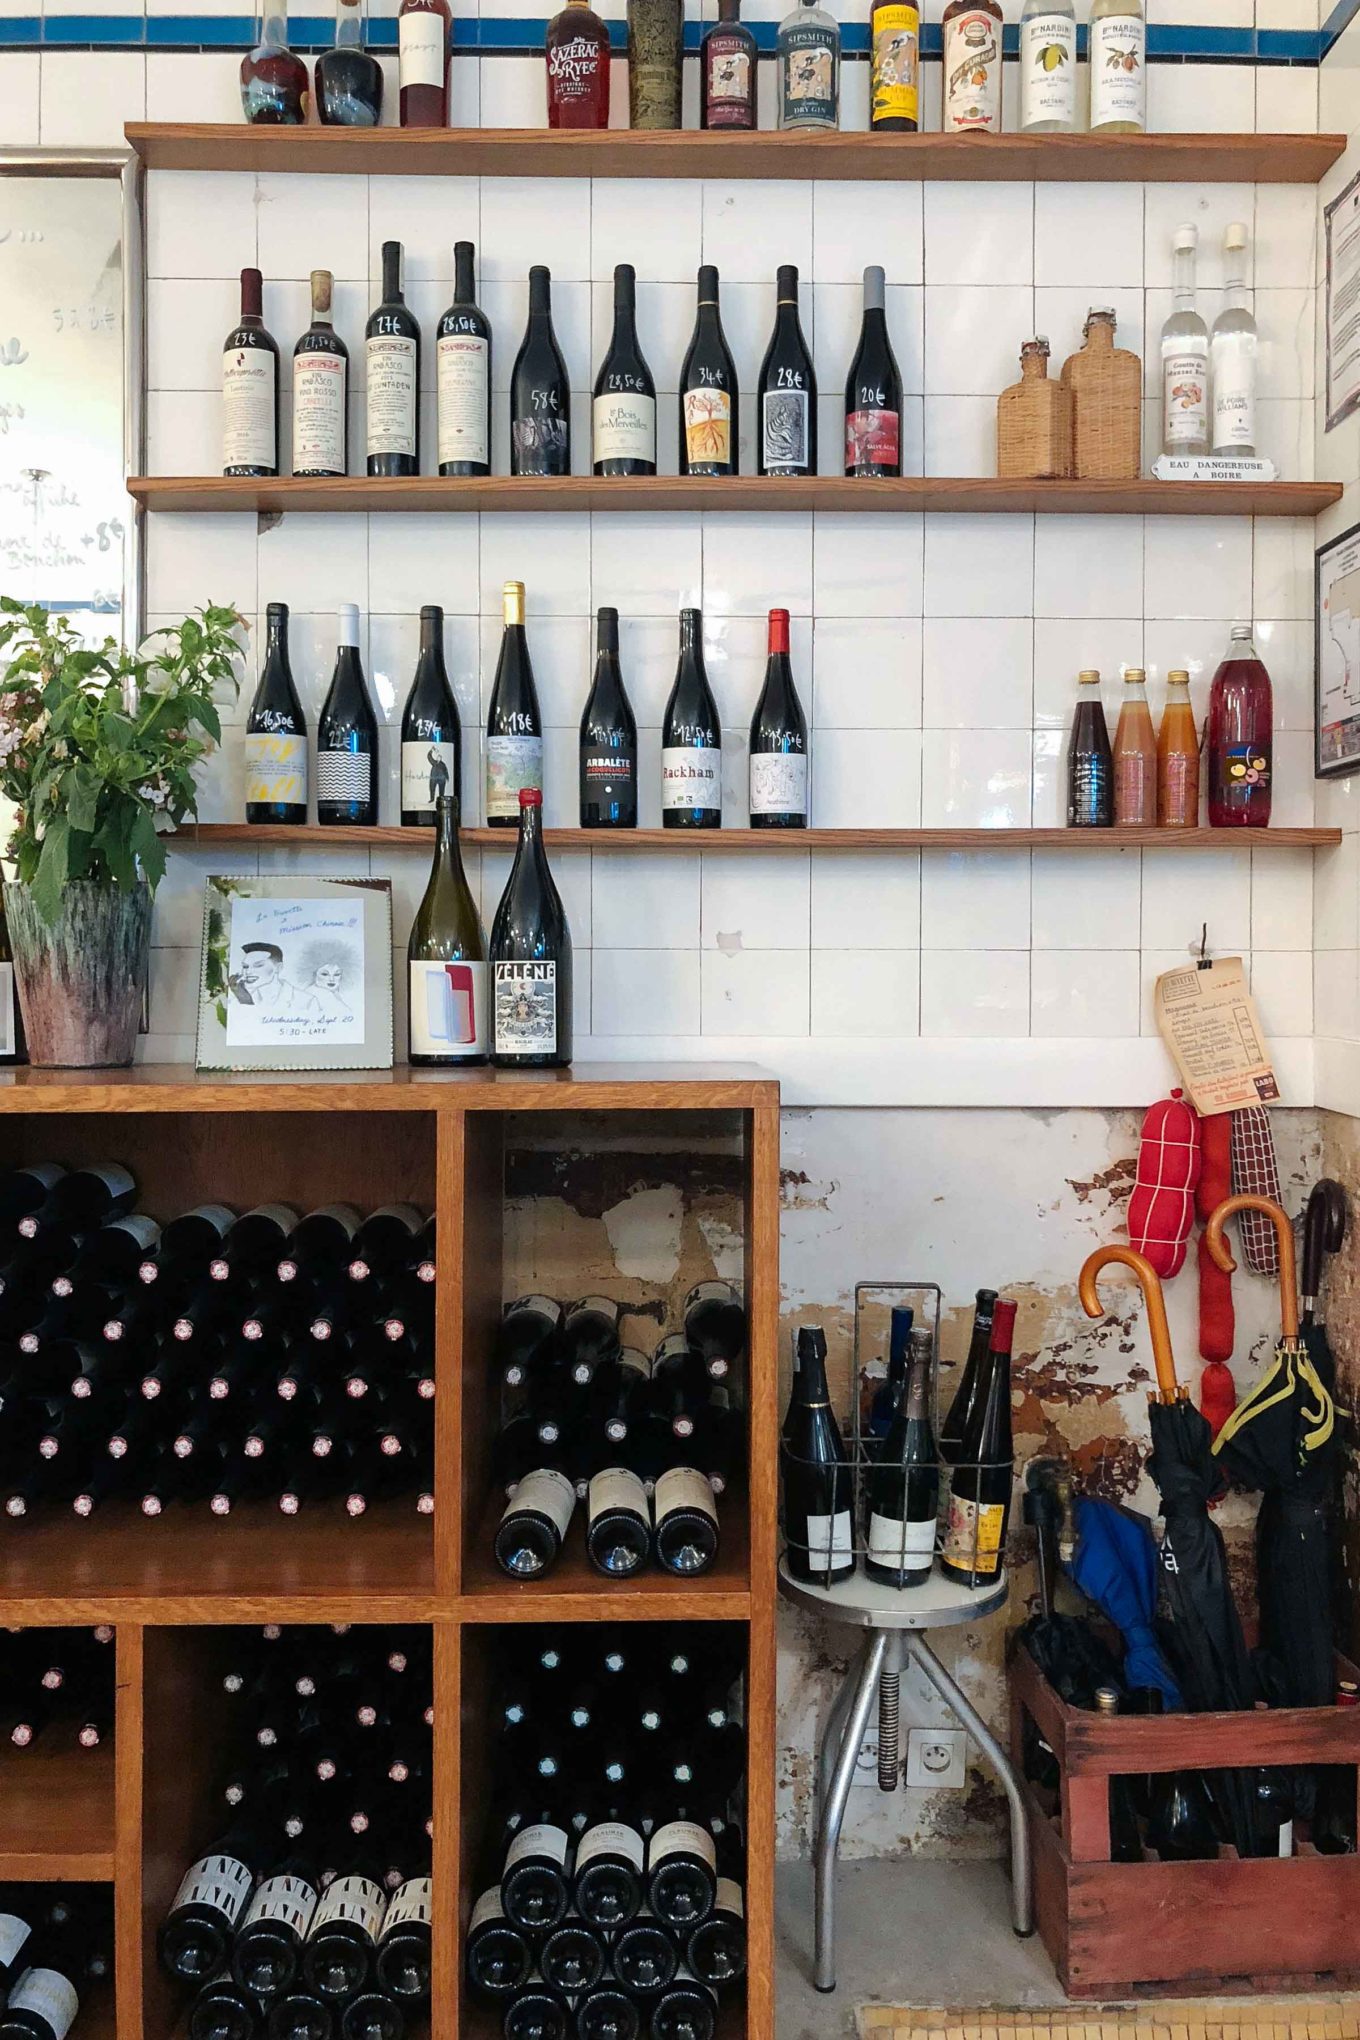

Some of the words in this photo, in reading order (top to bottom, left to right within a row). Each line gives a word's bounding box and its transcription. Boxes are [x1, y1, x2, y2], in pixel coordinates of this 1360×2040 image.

[711, 41, 749, 50] SIPSMITH
[788, 33, 832, 44] SIPSMITH
[549, 44, 599, 76] SAZERAC
[794, 105, 811, 115] DRY
[811, 105, 826, 114] GIN
[234, 332, 256, 346] 23€
[608, 373, 645, 391] 28,50€
[698, 366, 724, 385] 34€
[777, 367, 803, 389] 28€
[531, 389, 559, 411] 58€
[861, 386, 886, 406] 20€
[617, 407, 637, 419] Bois
[1198, 461, 1264, 470] DANGEREUSE
[1193, 471, 1200, 479] A
[1211, 471, 1243, 480] BOIRE
[507, 711, 534, 732] 18€
[663, 765, 714, 779] Rackham
[308, 1027, 327, 1035] LATE
